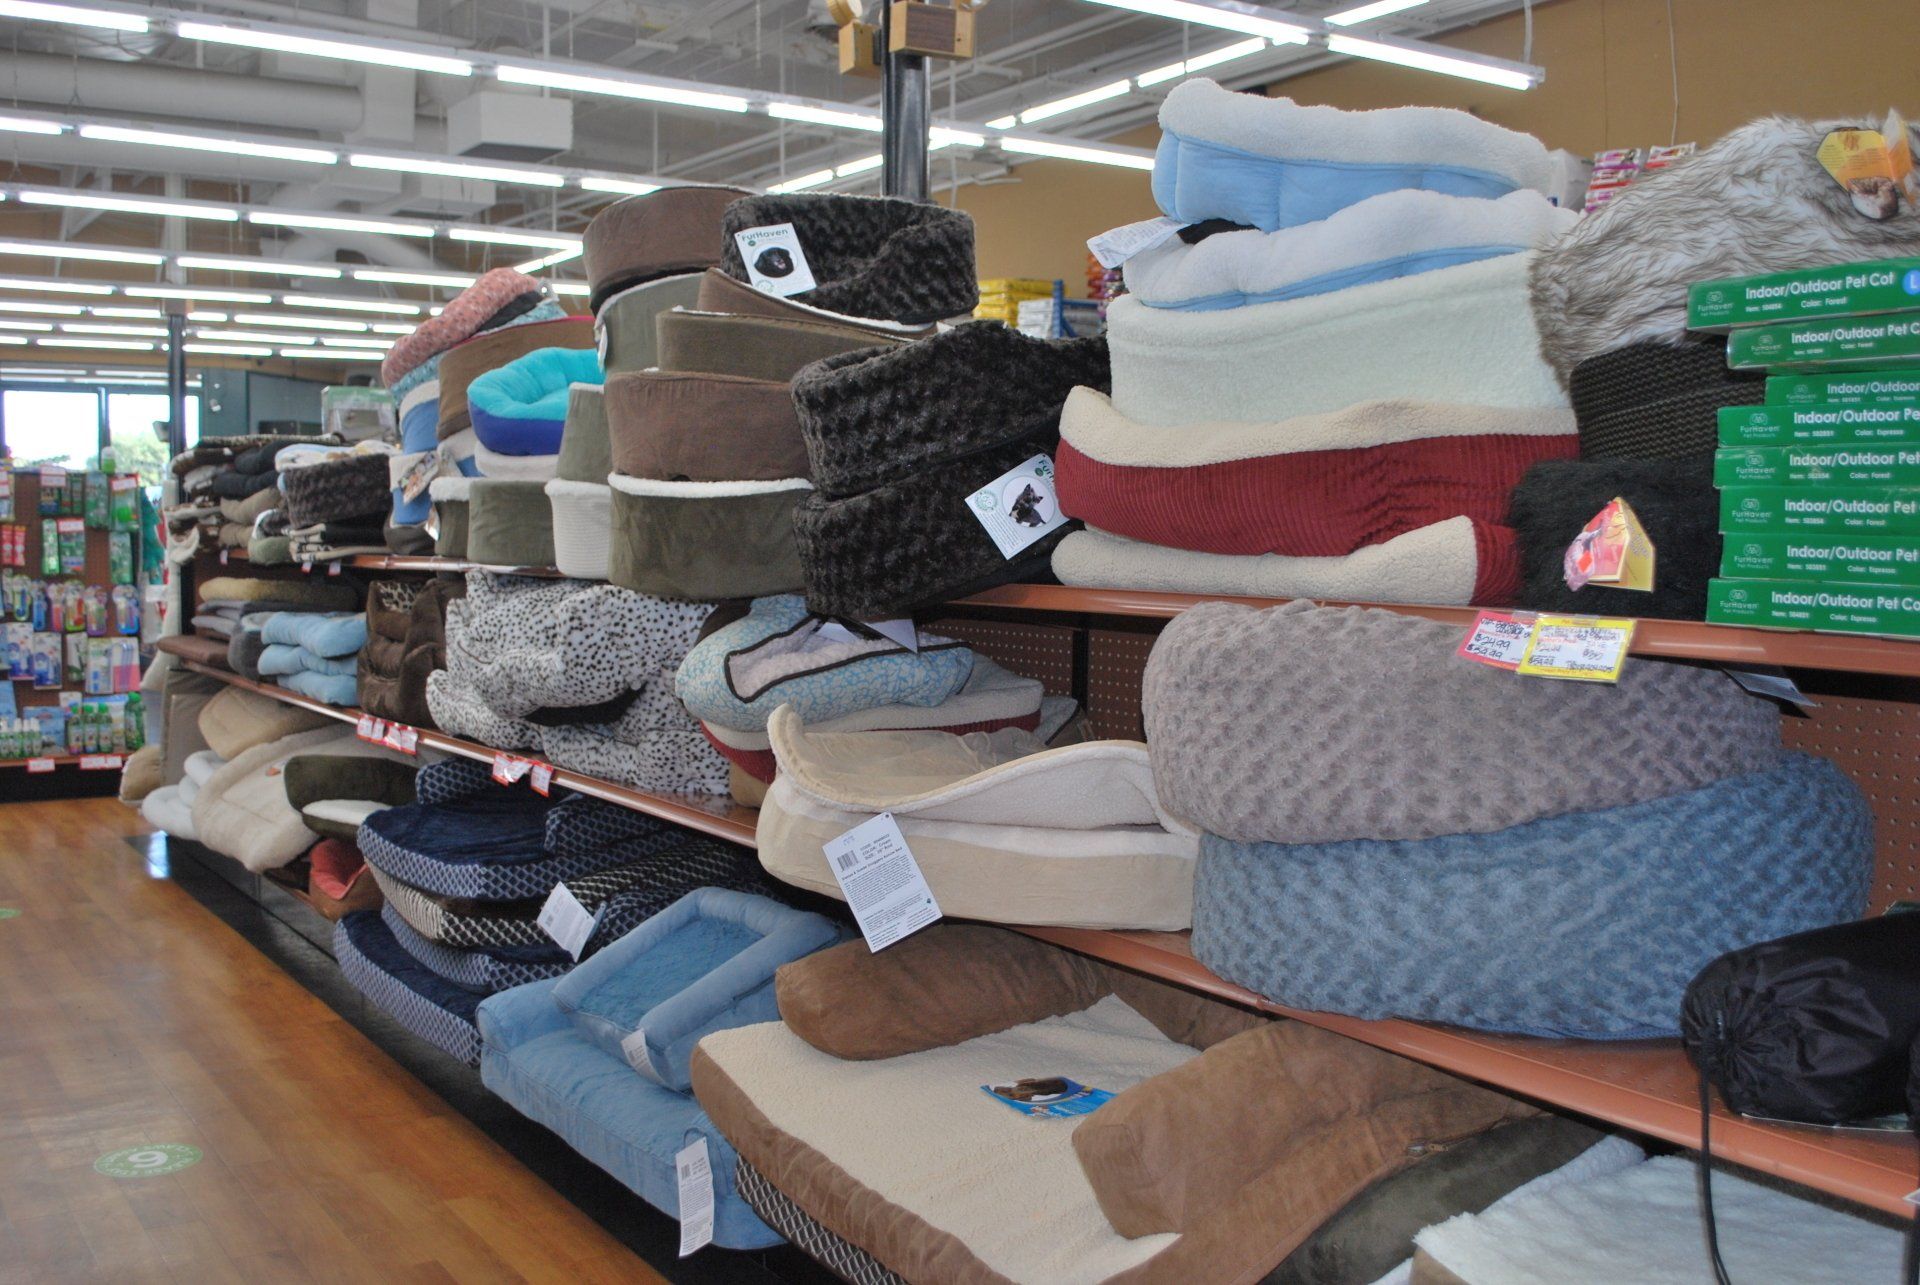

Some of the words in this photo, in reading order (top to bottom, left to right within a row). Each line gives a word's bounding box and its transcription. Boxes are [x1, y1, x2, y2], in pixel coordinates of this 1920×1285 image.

[742, 228, 788, 242] FurHaven
[1745, 278, 1842, 300] Indoor/Outdoor
[1845, 274, 1867, 289] Pet
[1869, 271, 1895, 286] Cot
[1801, 300, 1822, 308] Color:
[1825, 296, 1847, 306] Forest
[1792, 328, 1884, 344] Indoor/Outdoor
[1887, 324, 1908, 336] Pet
[1794, 409, 1900, 424] Indoor/Outdoor
[1790, 452, 1894, 466] Indoor/Outdoor
[1736, 466, 1775, 474] FurHaven
[1785, 499, 1889, 514] Indoor/Outdoor
[1894, 500, 1916, 514] Pet
[1732, 510, 1771, 518] FurHaven
[1734, 556, 1773, 564] FurHaven
[1787, 545, 1892, 560] Indoor/Outdoor
[1896, 548, 1918, 561] Pet
[1720, 600, 1758, 609] FurHaven
[1772, 591, 1874, 608] Indoor/Outdoor
[1876, 596, 1898, 609] Pet
